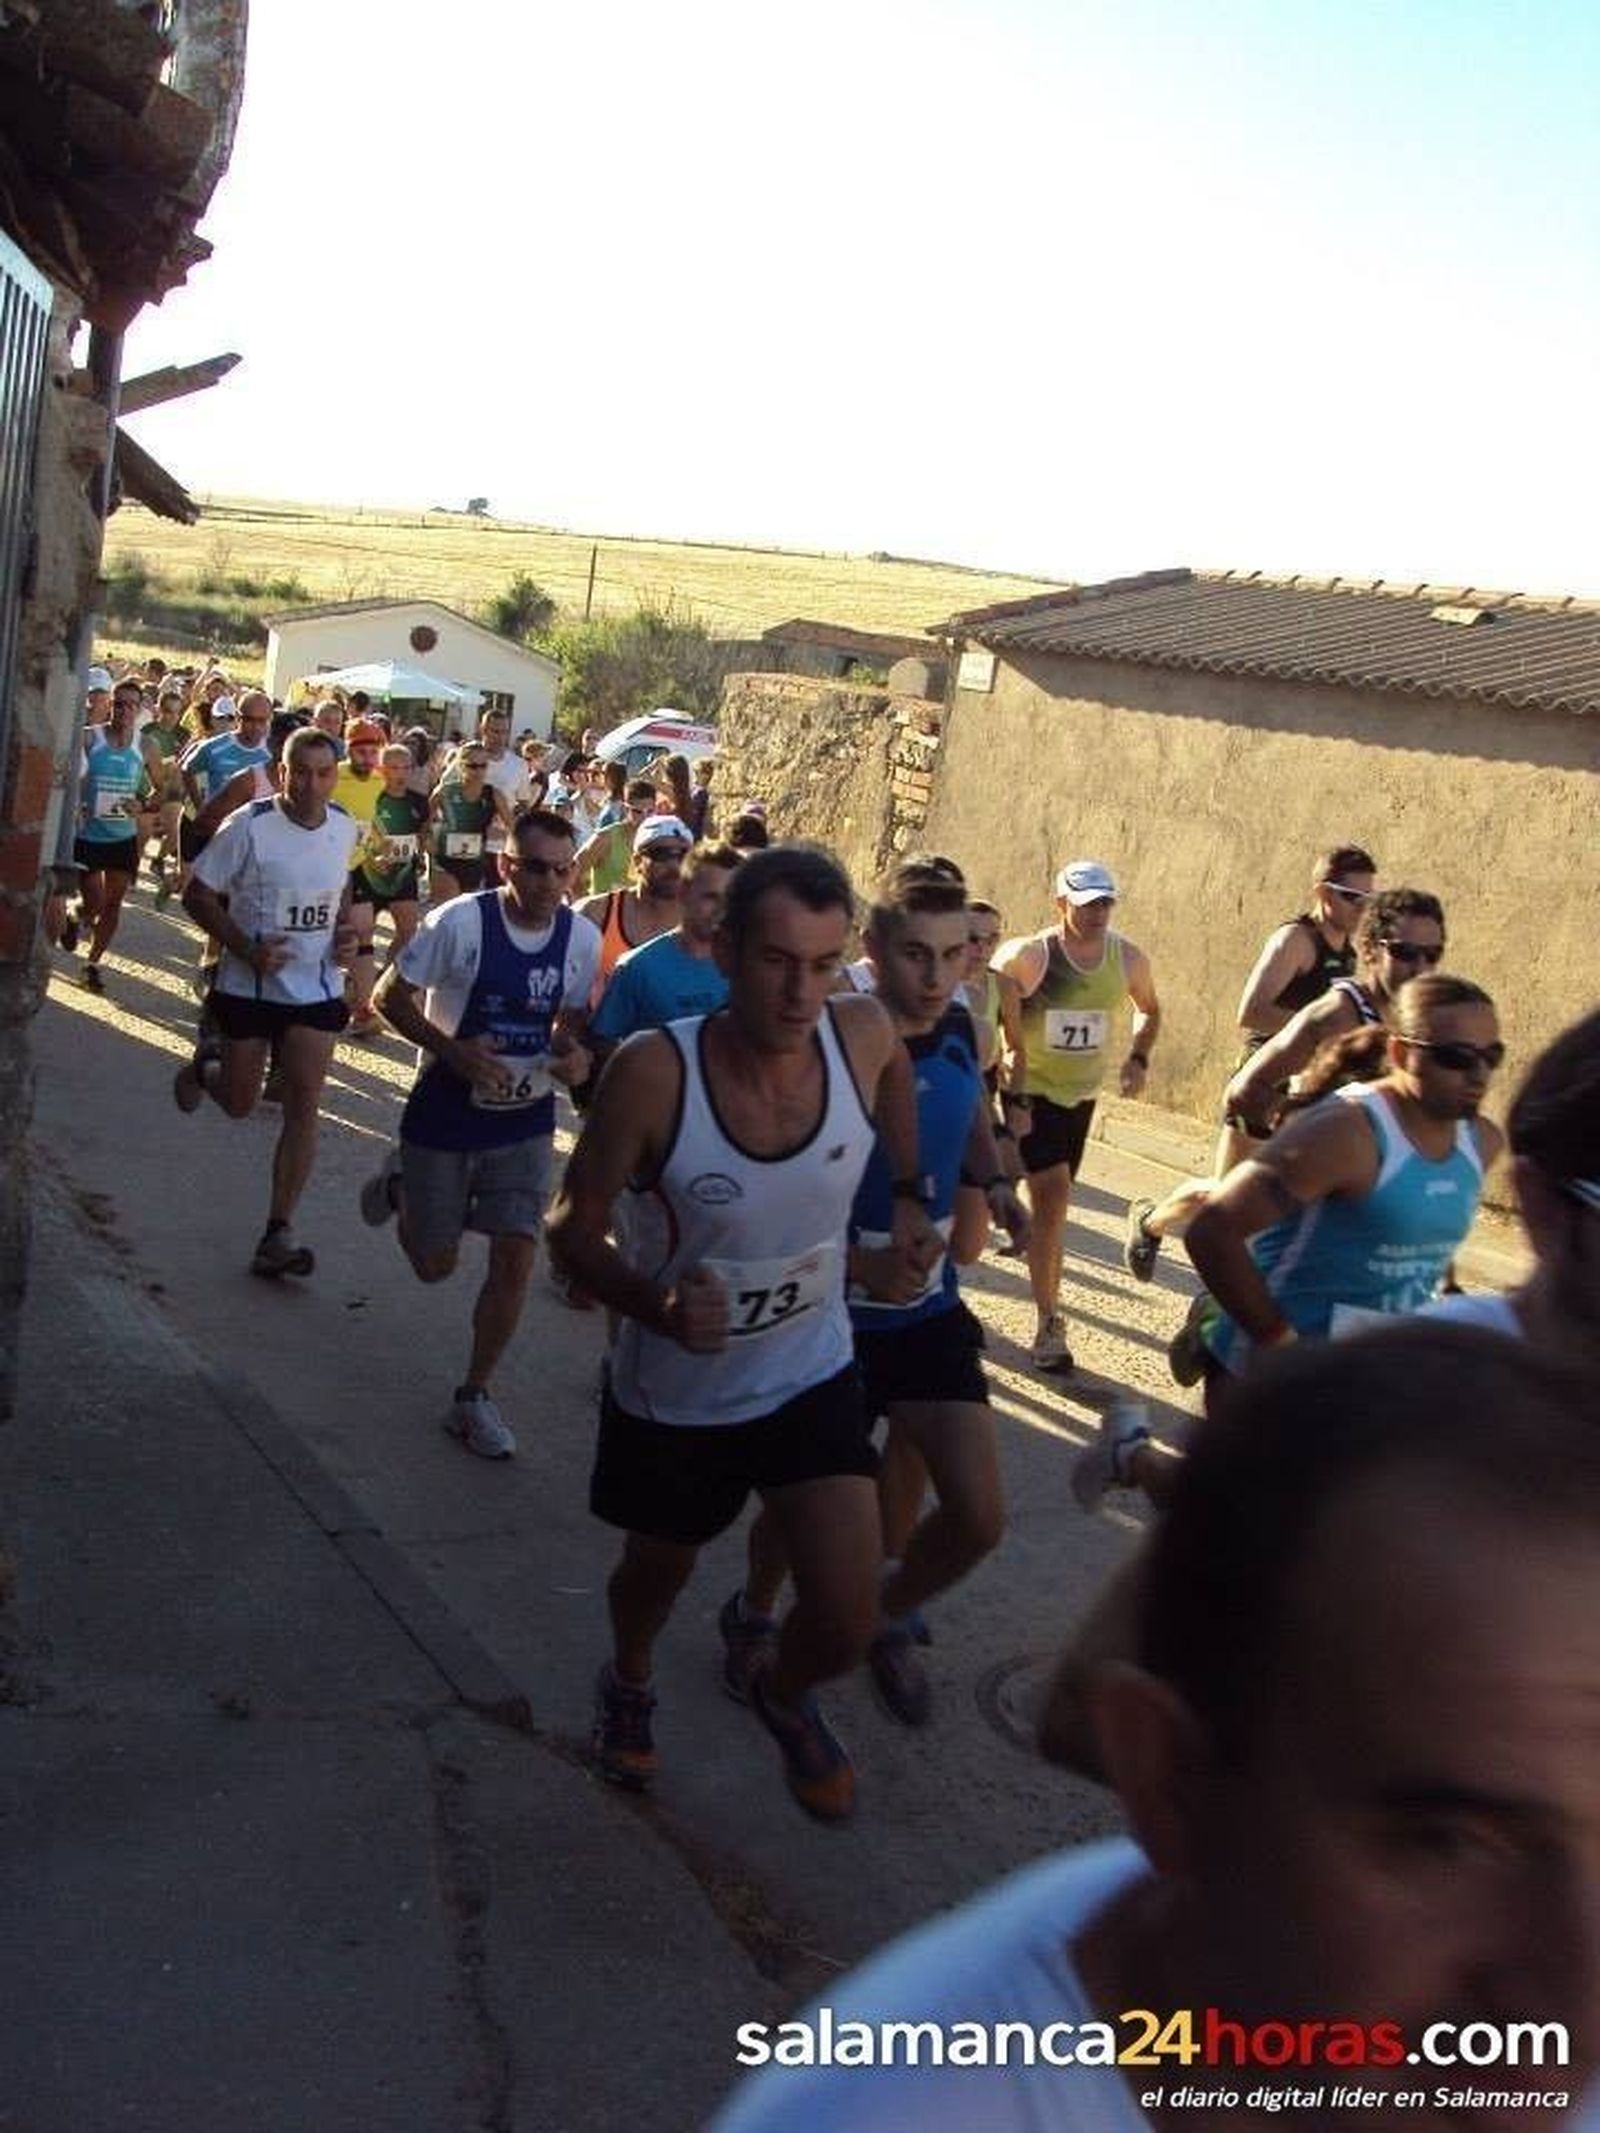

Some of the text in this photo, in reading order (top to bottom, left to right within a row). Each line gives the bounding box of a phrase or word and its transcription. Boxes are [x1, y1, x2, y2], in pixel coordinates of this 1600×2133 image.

[287, 904, 330, 926] 105
[1062, 1025, 1090, 1046] 71
[738, 1281, 800, 1325] 73
